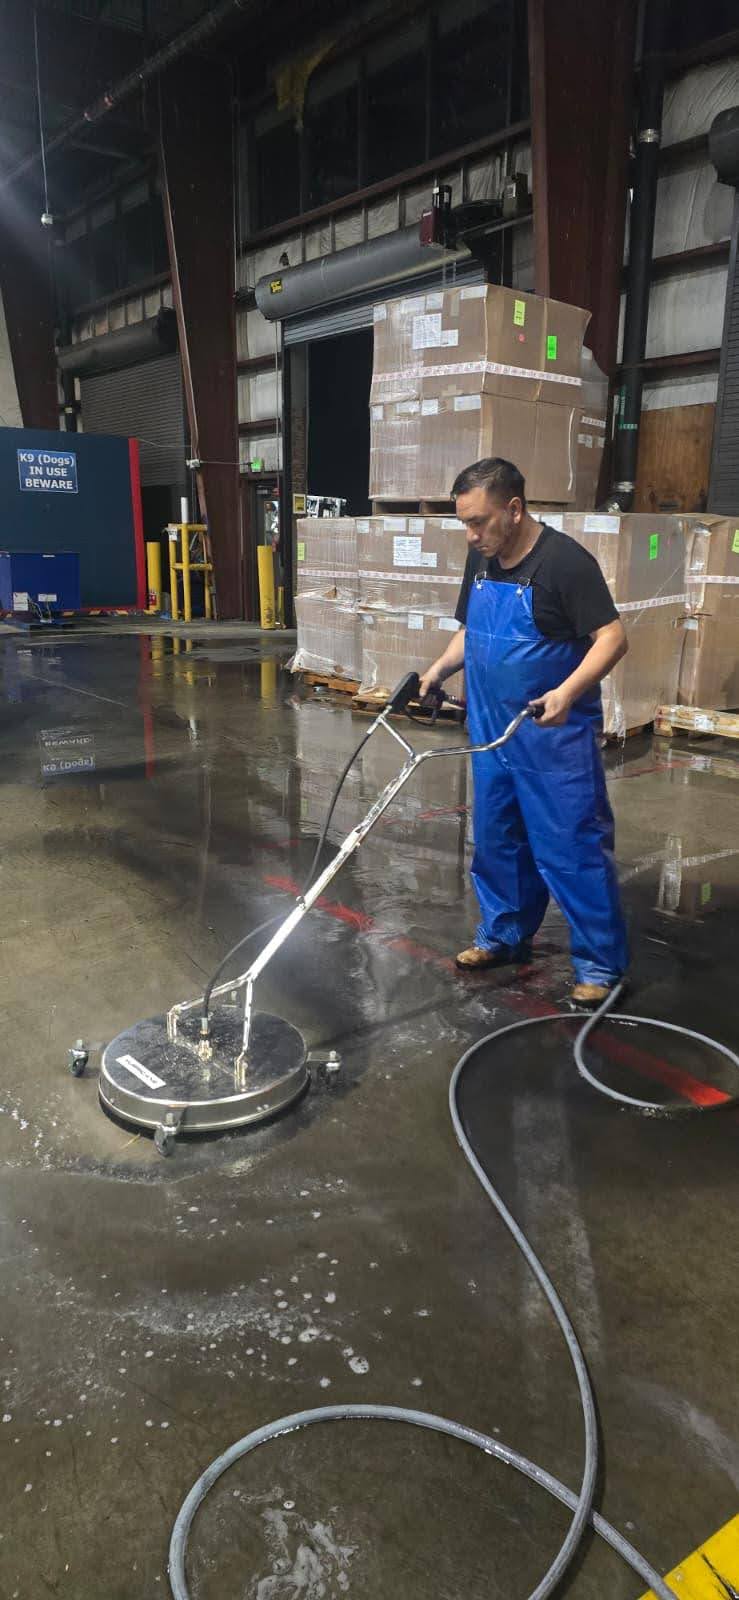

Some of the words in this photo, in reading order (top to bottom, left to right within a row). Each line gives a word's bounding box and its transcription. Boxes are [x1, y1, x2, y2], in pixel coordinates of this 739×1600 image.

[20, 453, 34, 463] K9
[38, 454, 74, 467] (Dogs)
[29, 466, 43, 476] IN
[46, 467, 68, 477] USE
[25, 478, 73, 490] BEWARE
